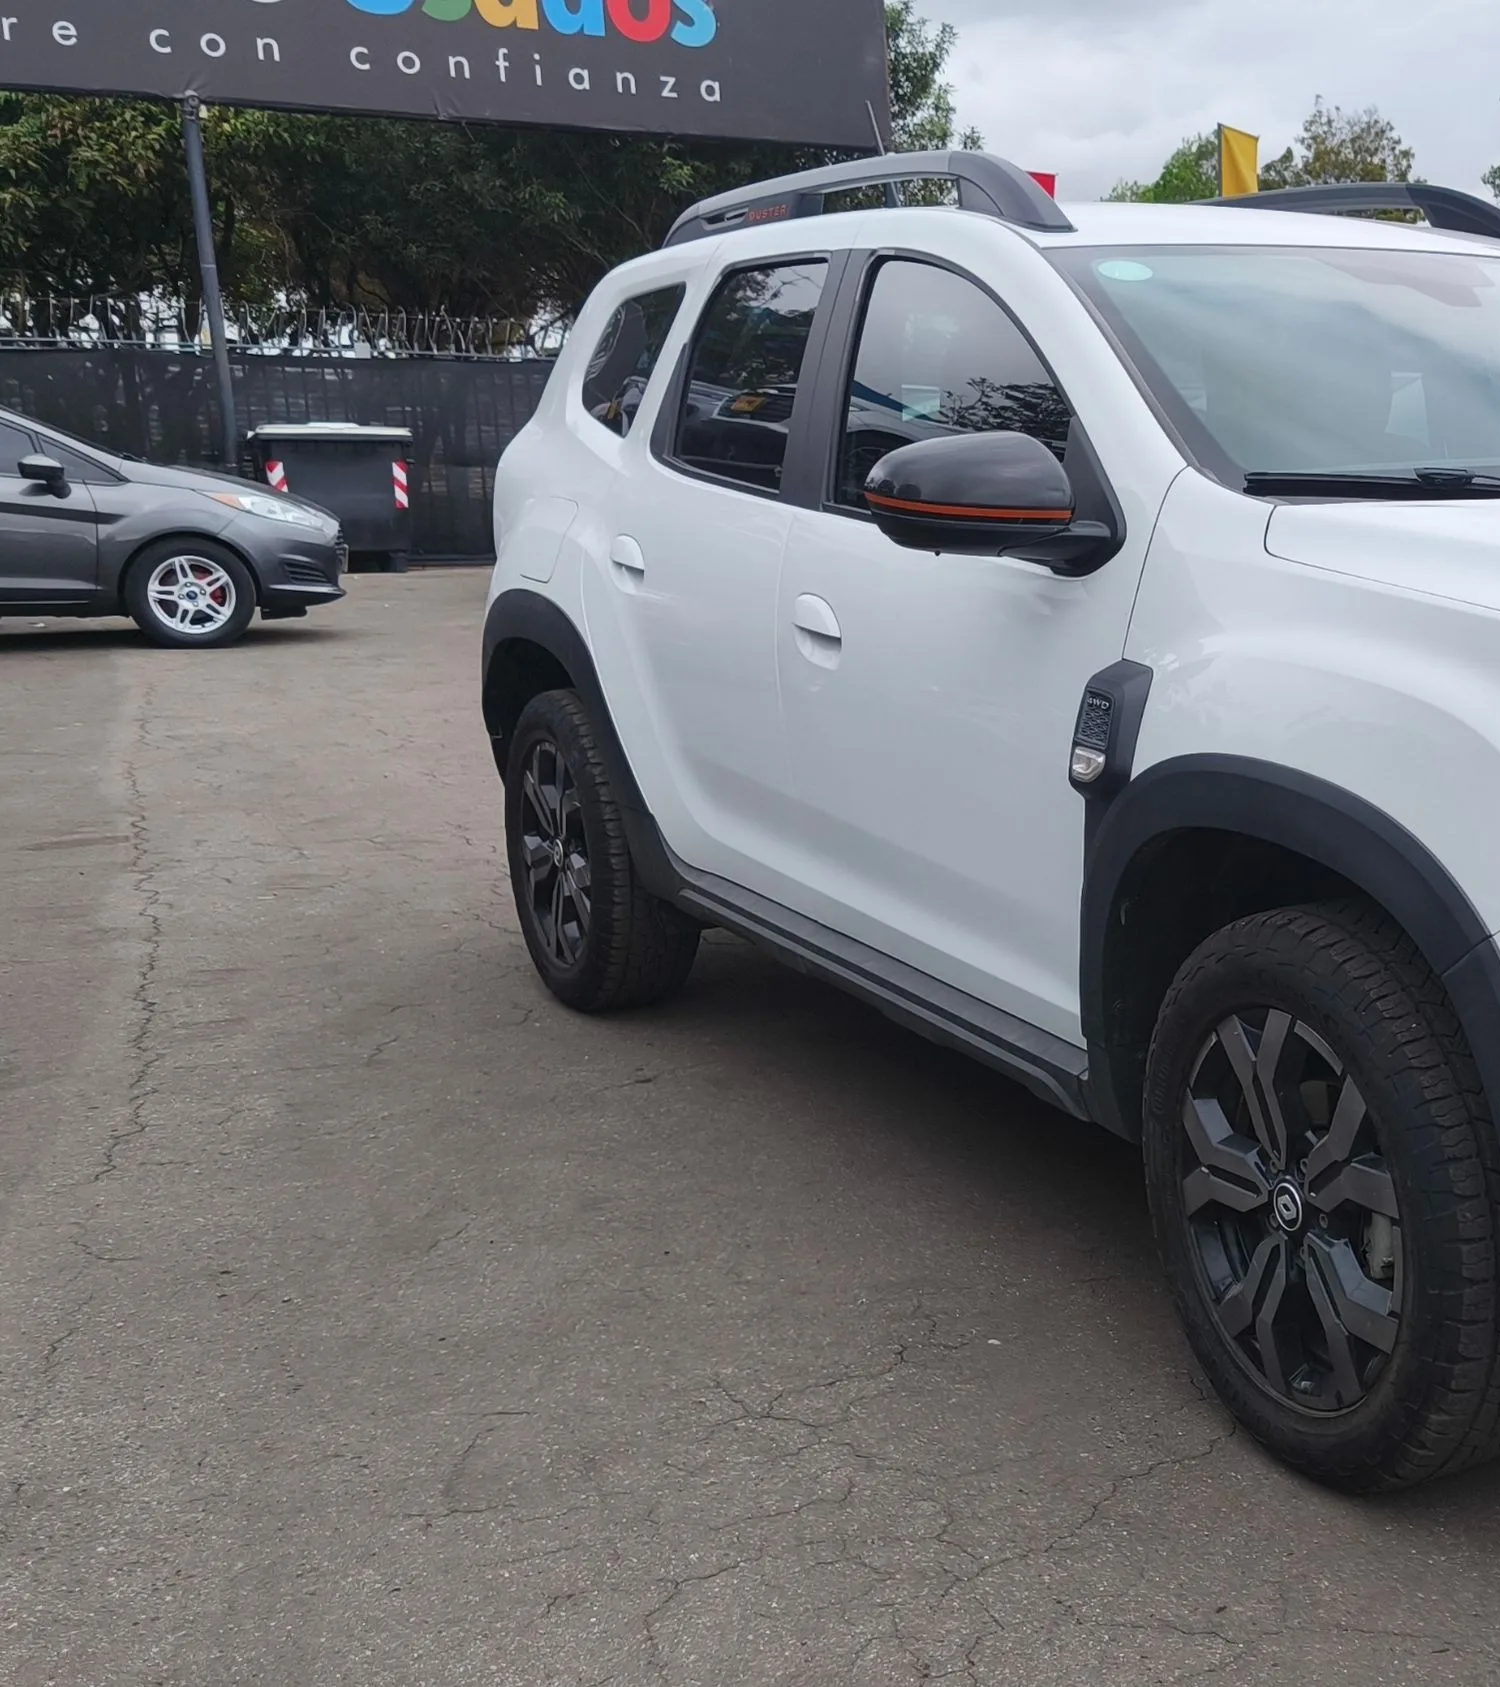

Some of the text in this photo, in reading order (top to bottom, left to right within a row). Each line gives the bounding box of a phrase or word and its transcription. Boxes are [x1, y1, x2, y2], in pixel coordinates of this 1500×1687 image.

[149, 28, 281, 62] con
[349, 44, 722, 102] confianza
[749, 204, 787, 220] DUSTER
[1087, 697, 1109, 709] 4WD
